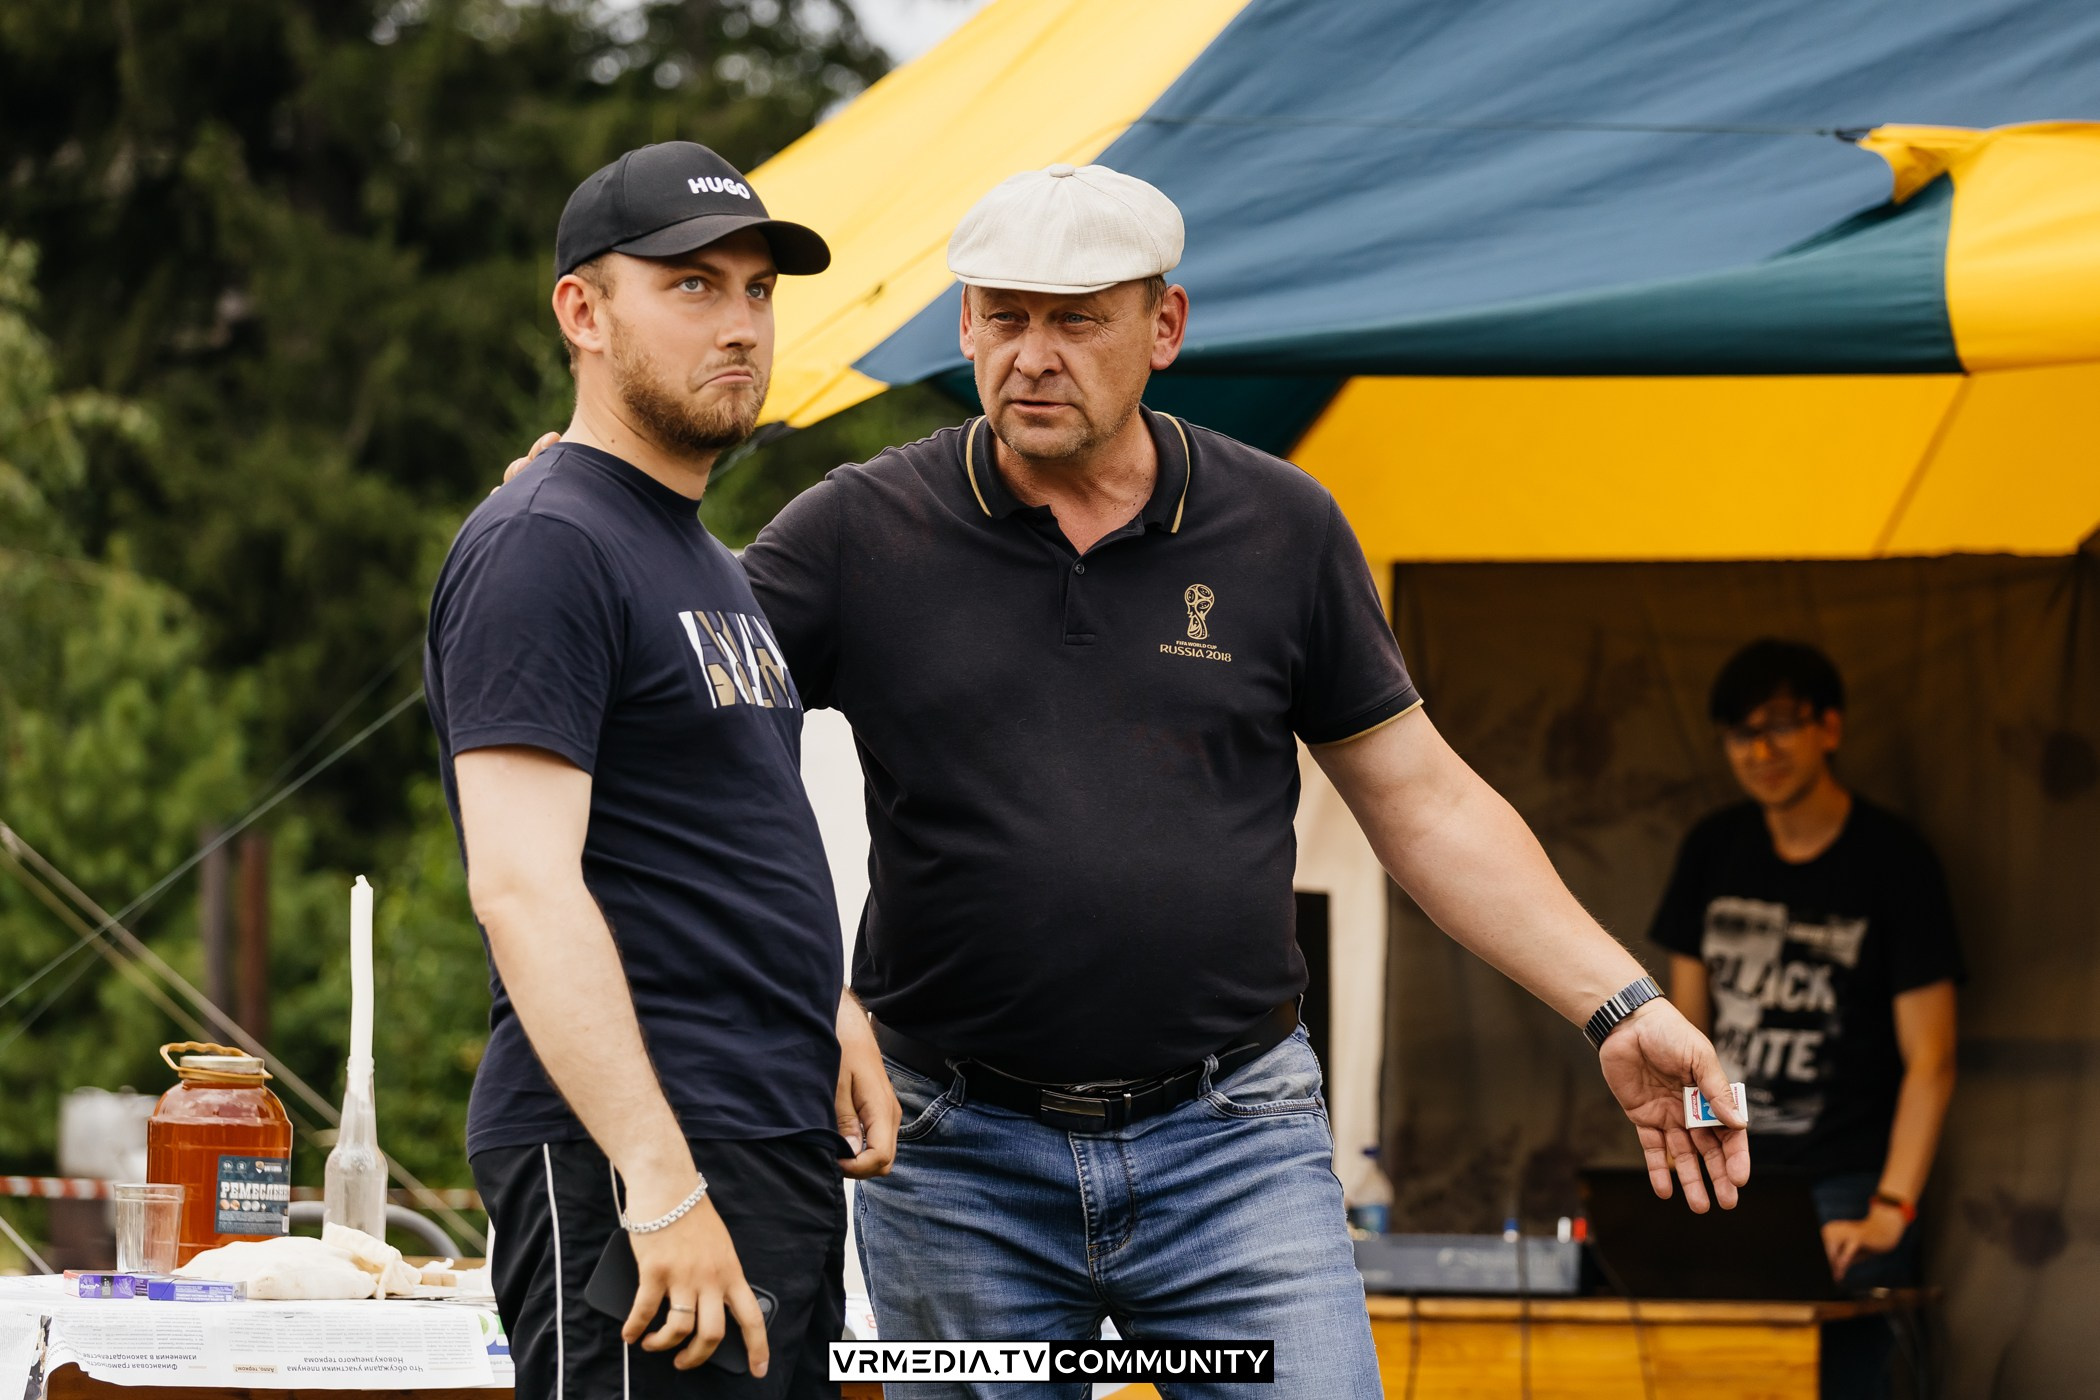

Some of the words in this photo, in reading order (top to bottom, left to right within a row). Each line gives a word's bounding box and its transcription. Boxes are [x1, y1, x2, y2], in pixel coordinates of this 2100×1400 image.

[688, 177, 750, 199] HUGO
[1160, 644, 1204, 658] RUSSIA
[1205, 650, 1232, 662] 2018
[338, 1356, 403, 1364] Новокузнецкого
[286, 1365, 320, 1373] пленума
[321, 1365, 363, 1373] участники
[364, 1365, 408, 1373] обсуждали
[409, 1365, 424, 1373] Что
